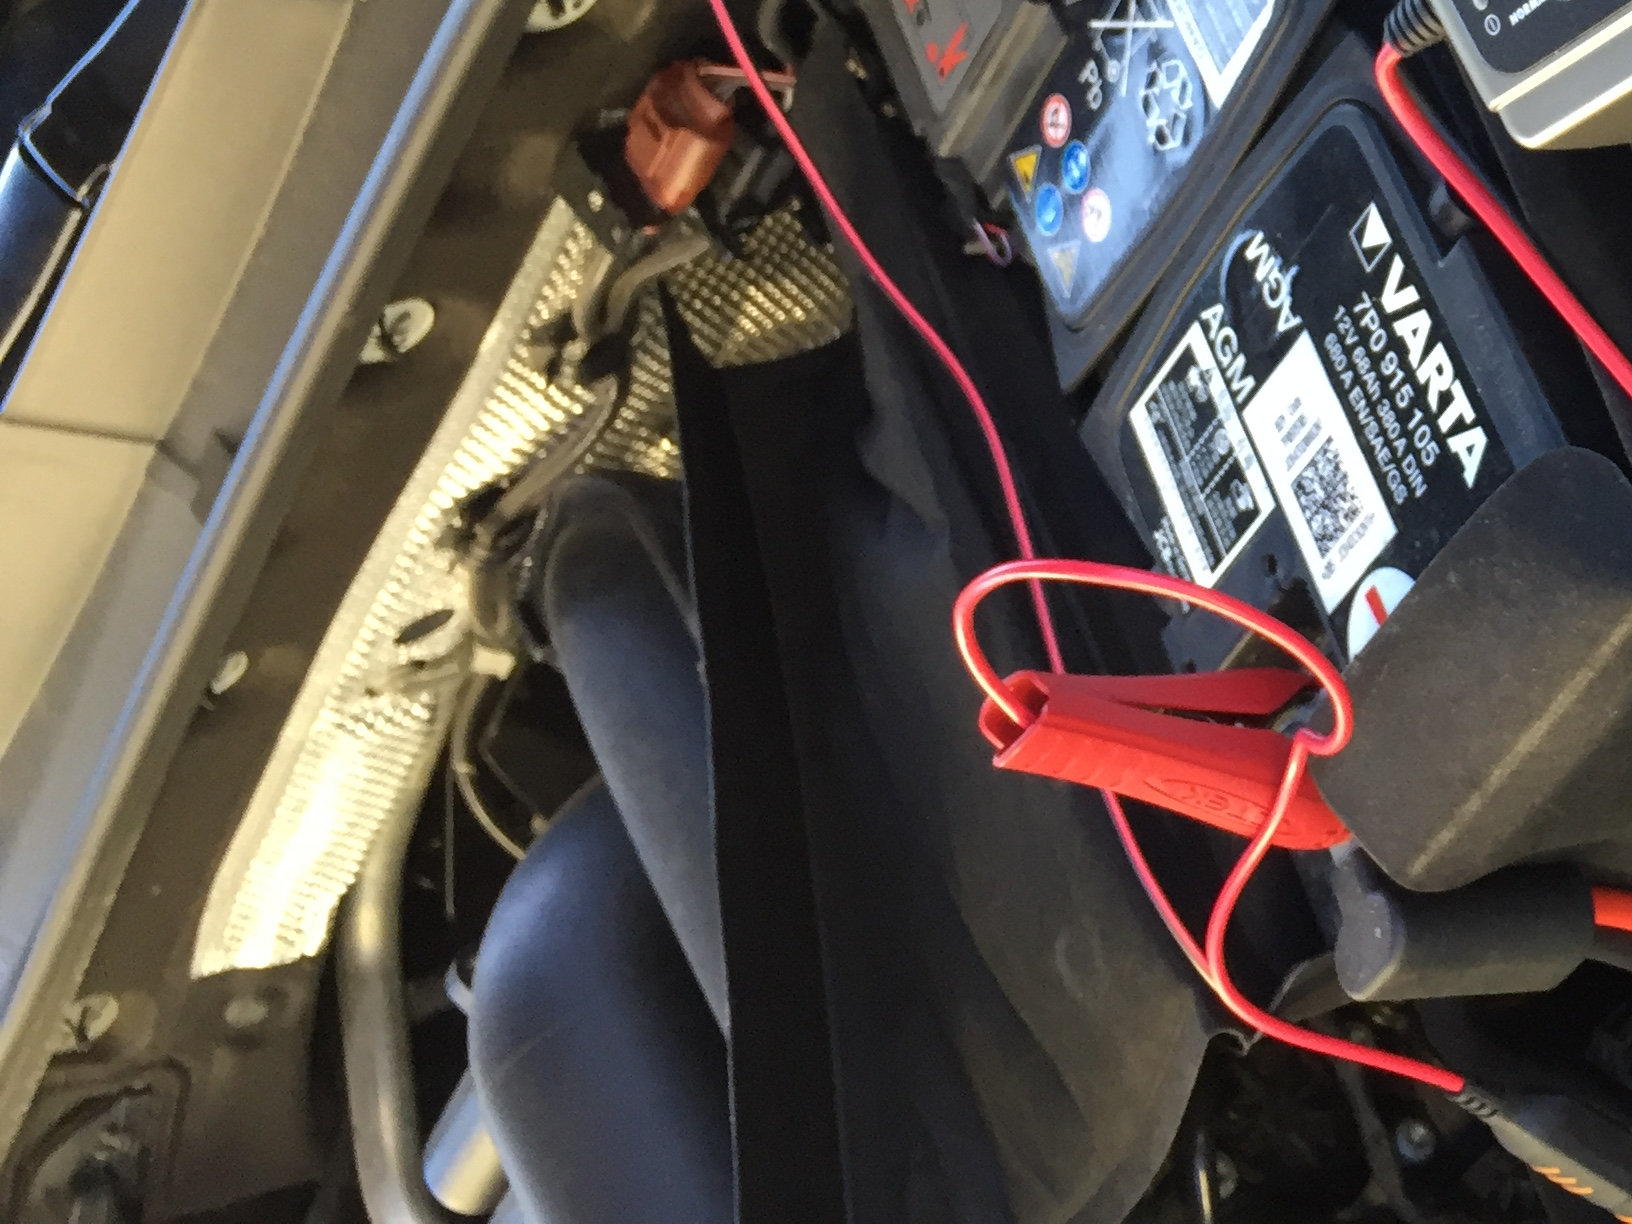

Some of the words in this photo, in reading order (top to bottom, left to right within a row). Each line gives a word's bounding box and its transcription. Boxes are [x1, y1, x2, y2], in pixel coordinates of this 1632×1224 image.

[1200, 303, 1256, 403] AGM
[1245, 231, 1303, 332] AGM
[1333, 304, 1359, 345] 12V
[1402, 453, 1429, 498] DIN
[1353, 291, 1388, 352] 7P0
[1380, 351, 1415, 408] 915
[1408, 407, 1440, 466] 105
[1381, 253, 1488, 488] VARTA
